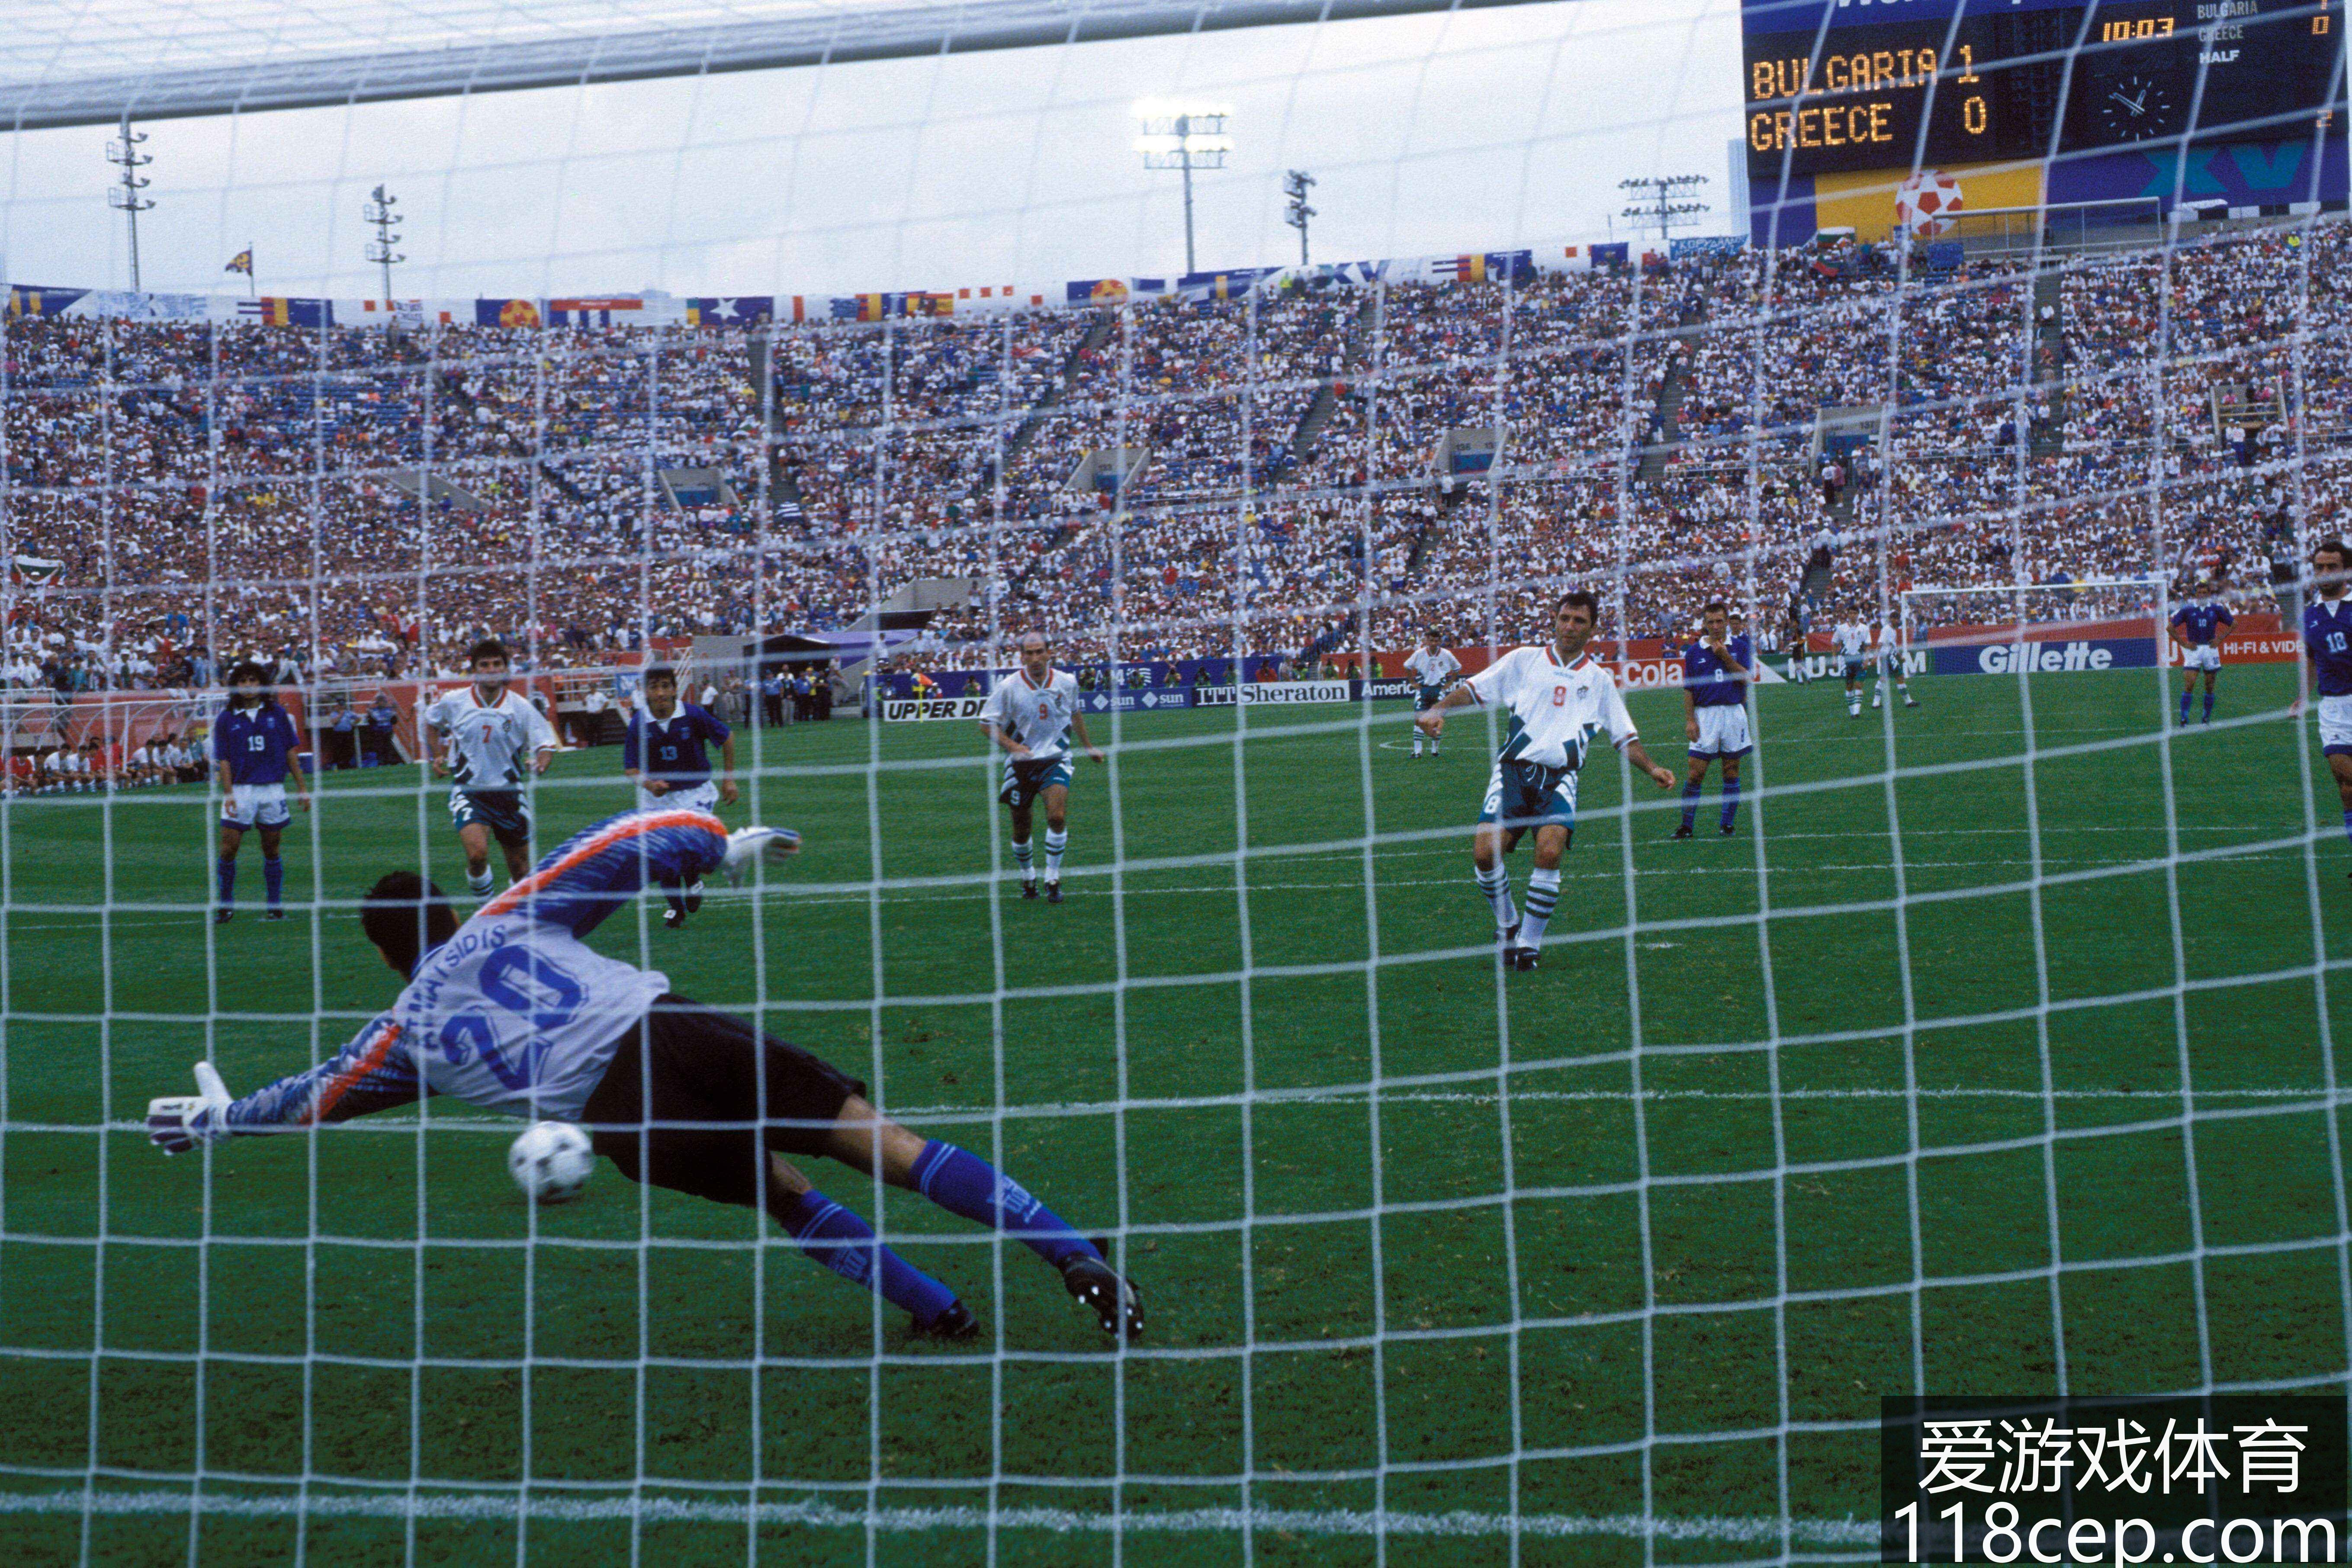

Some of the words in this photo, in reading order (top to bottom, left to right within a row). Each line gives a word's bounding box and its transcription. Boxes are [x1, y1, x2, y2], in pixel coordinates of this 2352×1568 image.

[2198, 1, 2258, 19] BULGARIA
[2103, 17, 2175, 42] 10:03
[2312, 16, 2330, 35] 0
[2199, 50, 2240, 64] HALF
[1753, 48, 1937, 99] BULGARIA
[1958, 45, 1979, 84] 1
[1751, 103, 1893, 151] GREECE
[1963, 96, 1987, 134] 0
[2223, 641, 2256, 655] HI-FI
[2259, 641, 2270, 653] &
[2271, 640, 2305, 654] VIDE
[1979, 641, 2113, 674] Gillette
[1601, 661, 1683, 688] -Cola
[1715, 668, 1724, 682] 8
[1196, 686, 1236, 705] ITT
[1240, 684, 1346, 704] Sheraton
[1362, 681, 1417, 696] Americ
[1553, 685, 1566, 707] 8
[1111, 696, 1135, 707] sun
[1159, 694, 1185, 704] sun
[888, 701, 957, 720] UPPER
[1039, 704, 1048, 720] 9
[482, 725, 492, 743] 7
[247, 736, 265, 752] 19
[659, 745, 678, 761] 13
[1484, 794, 1503, 814] 8
[462, 807, 473, 821] 7
[439, 943, 589, 1092] 20
